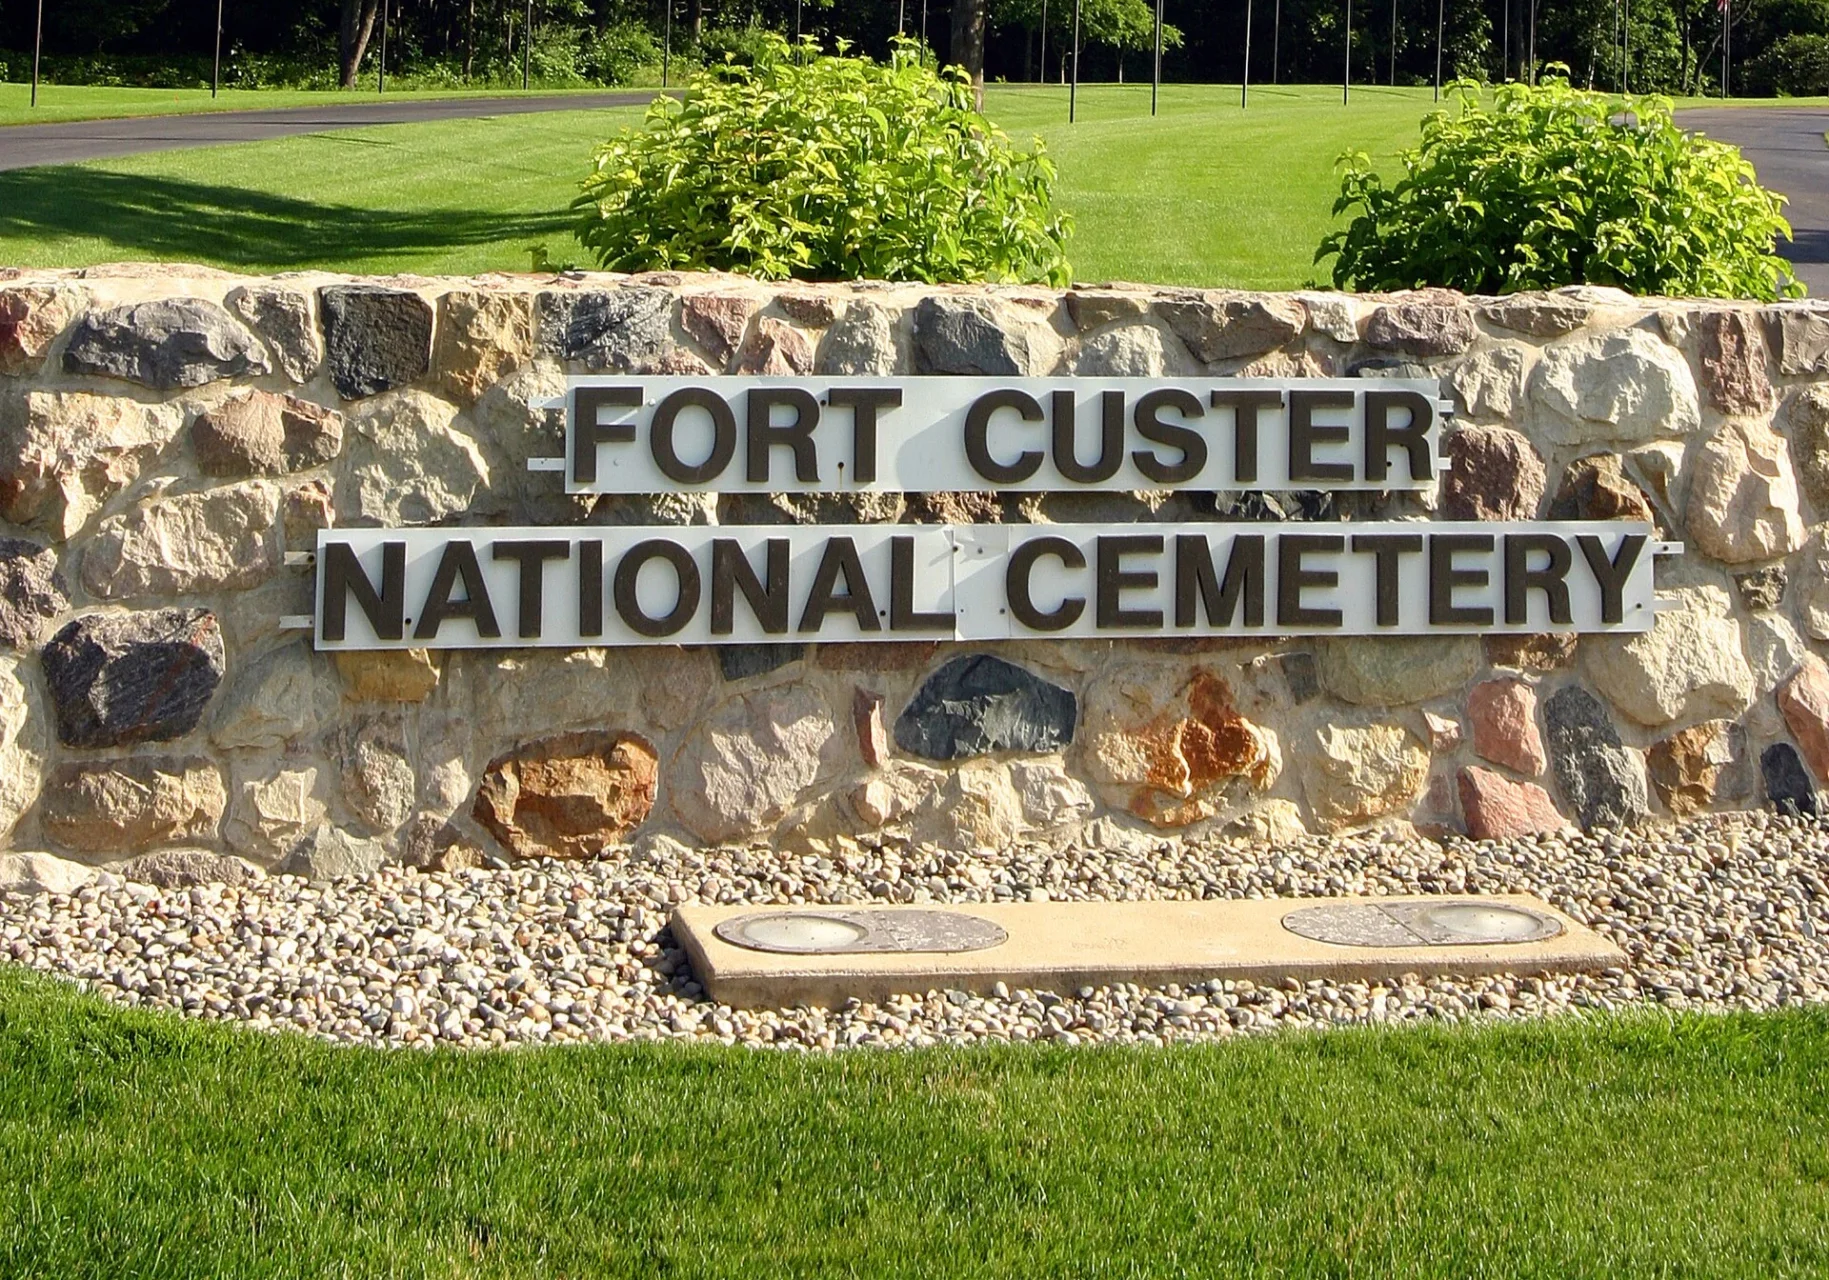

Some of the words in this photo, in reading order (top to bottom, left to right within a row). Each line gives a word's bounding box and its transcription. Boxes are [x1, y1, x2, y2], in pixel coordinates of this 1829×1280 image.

[573, 386, 903, 484] FORT
[964, 388, 1435, 483] CUSTER
[322, 537, 957, 641] NATIONAL
[1006, 533, 1646, 631] CEMETERY
